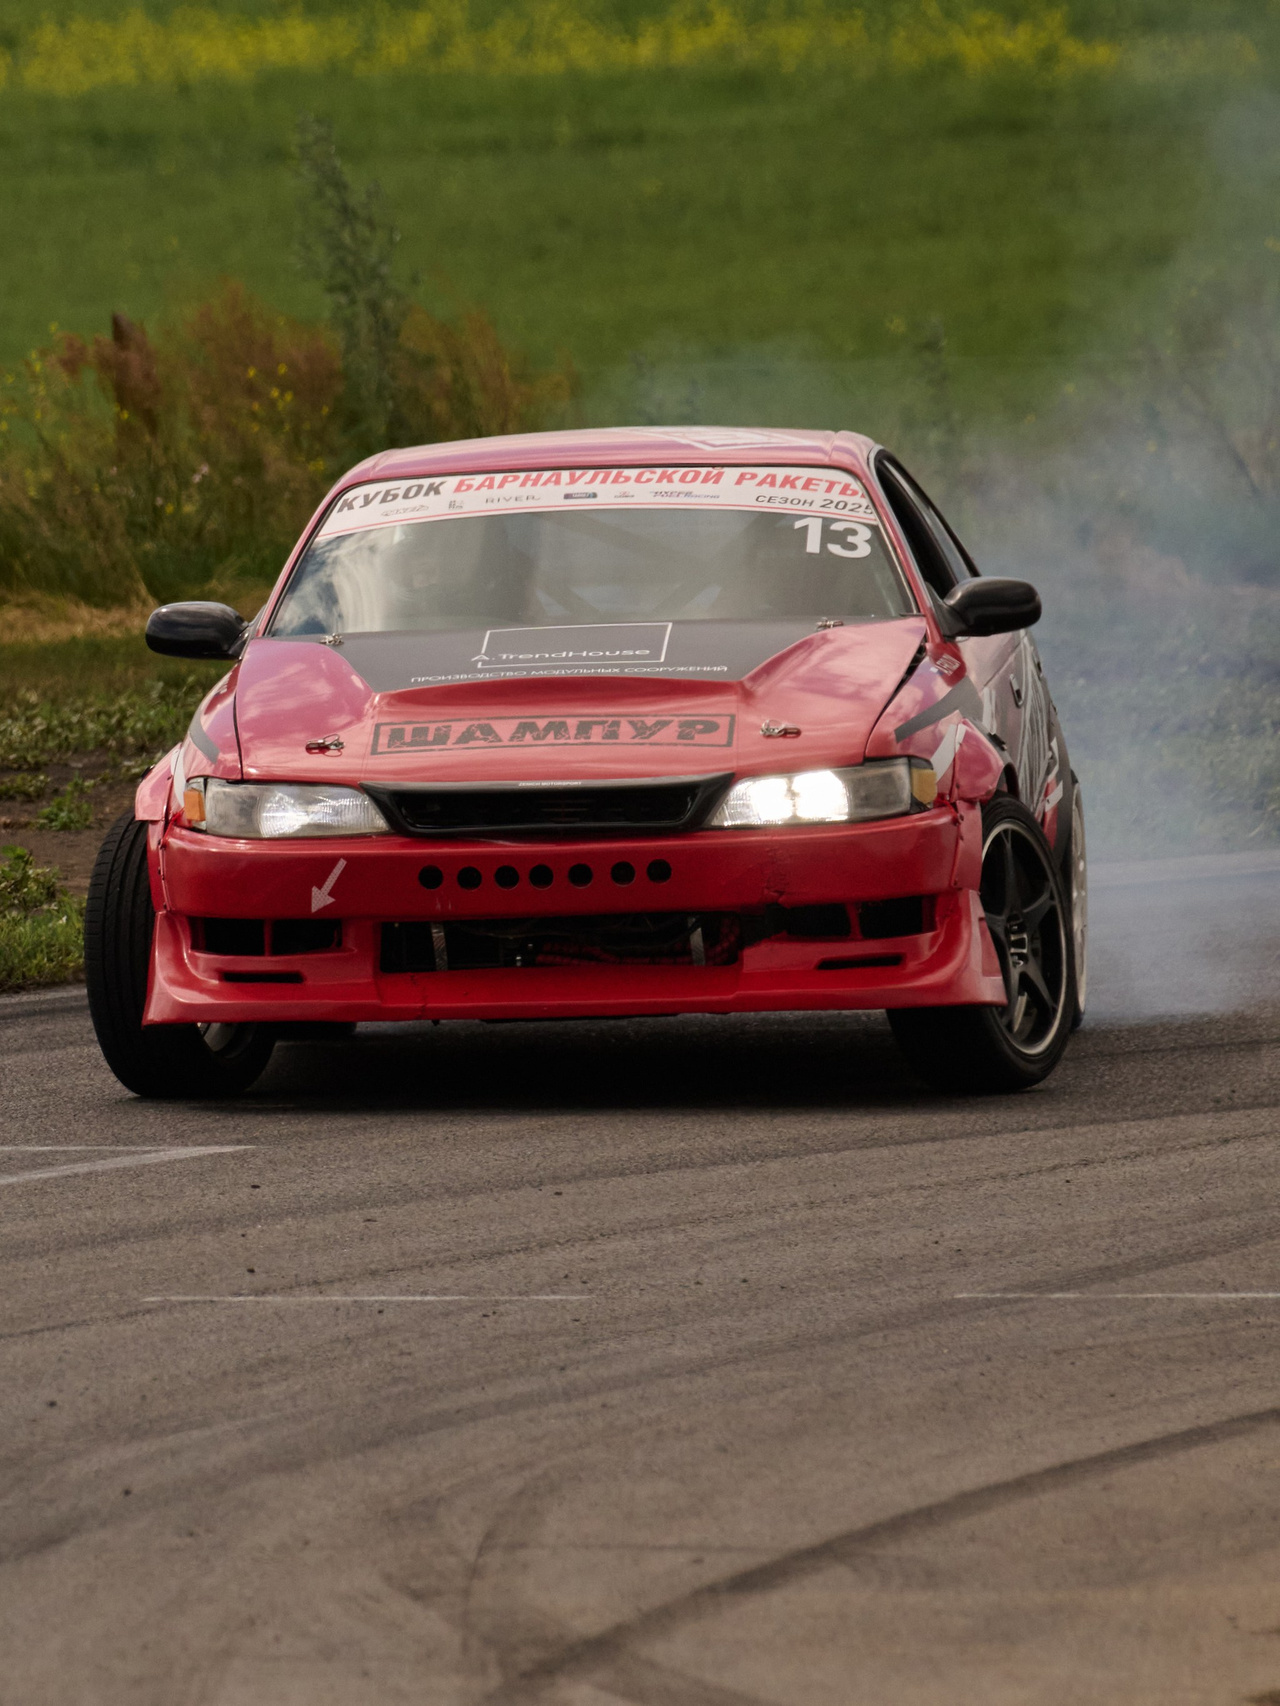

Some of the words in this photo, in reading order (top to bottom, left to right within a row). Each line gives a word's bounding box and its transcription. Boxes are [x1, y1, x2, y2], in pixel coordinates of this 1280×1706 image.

[336, 480, 447, 513] КУБОК
[453, 466, 723, 493] БАРНАУЛЬСКОЙ
[755, 495, 815, 507] СЕЗОН
[820, 498, 873, 515] 2025
[794, 517, 872, 559] 13
[410, 670, 527, 683] ПРОИЗВОДСТВО
[530, 667, 620, 676] МОДУЛЬНЫХ
[623, 665, 728, 673] СООРУЖЕНИЙ
[386, 719, 720, 749] ШАМПУР
